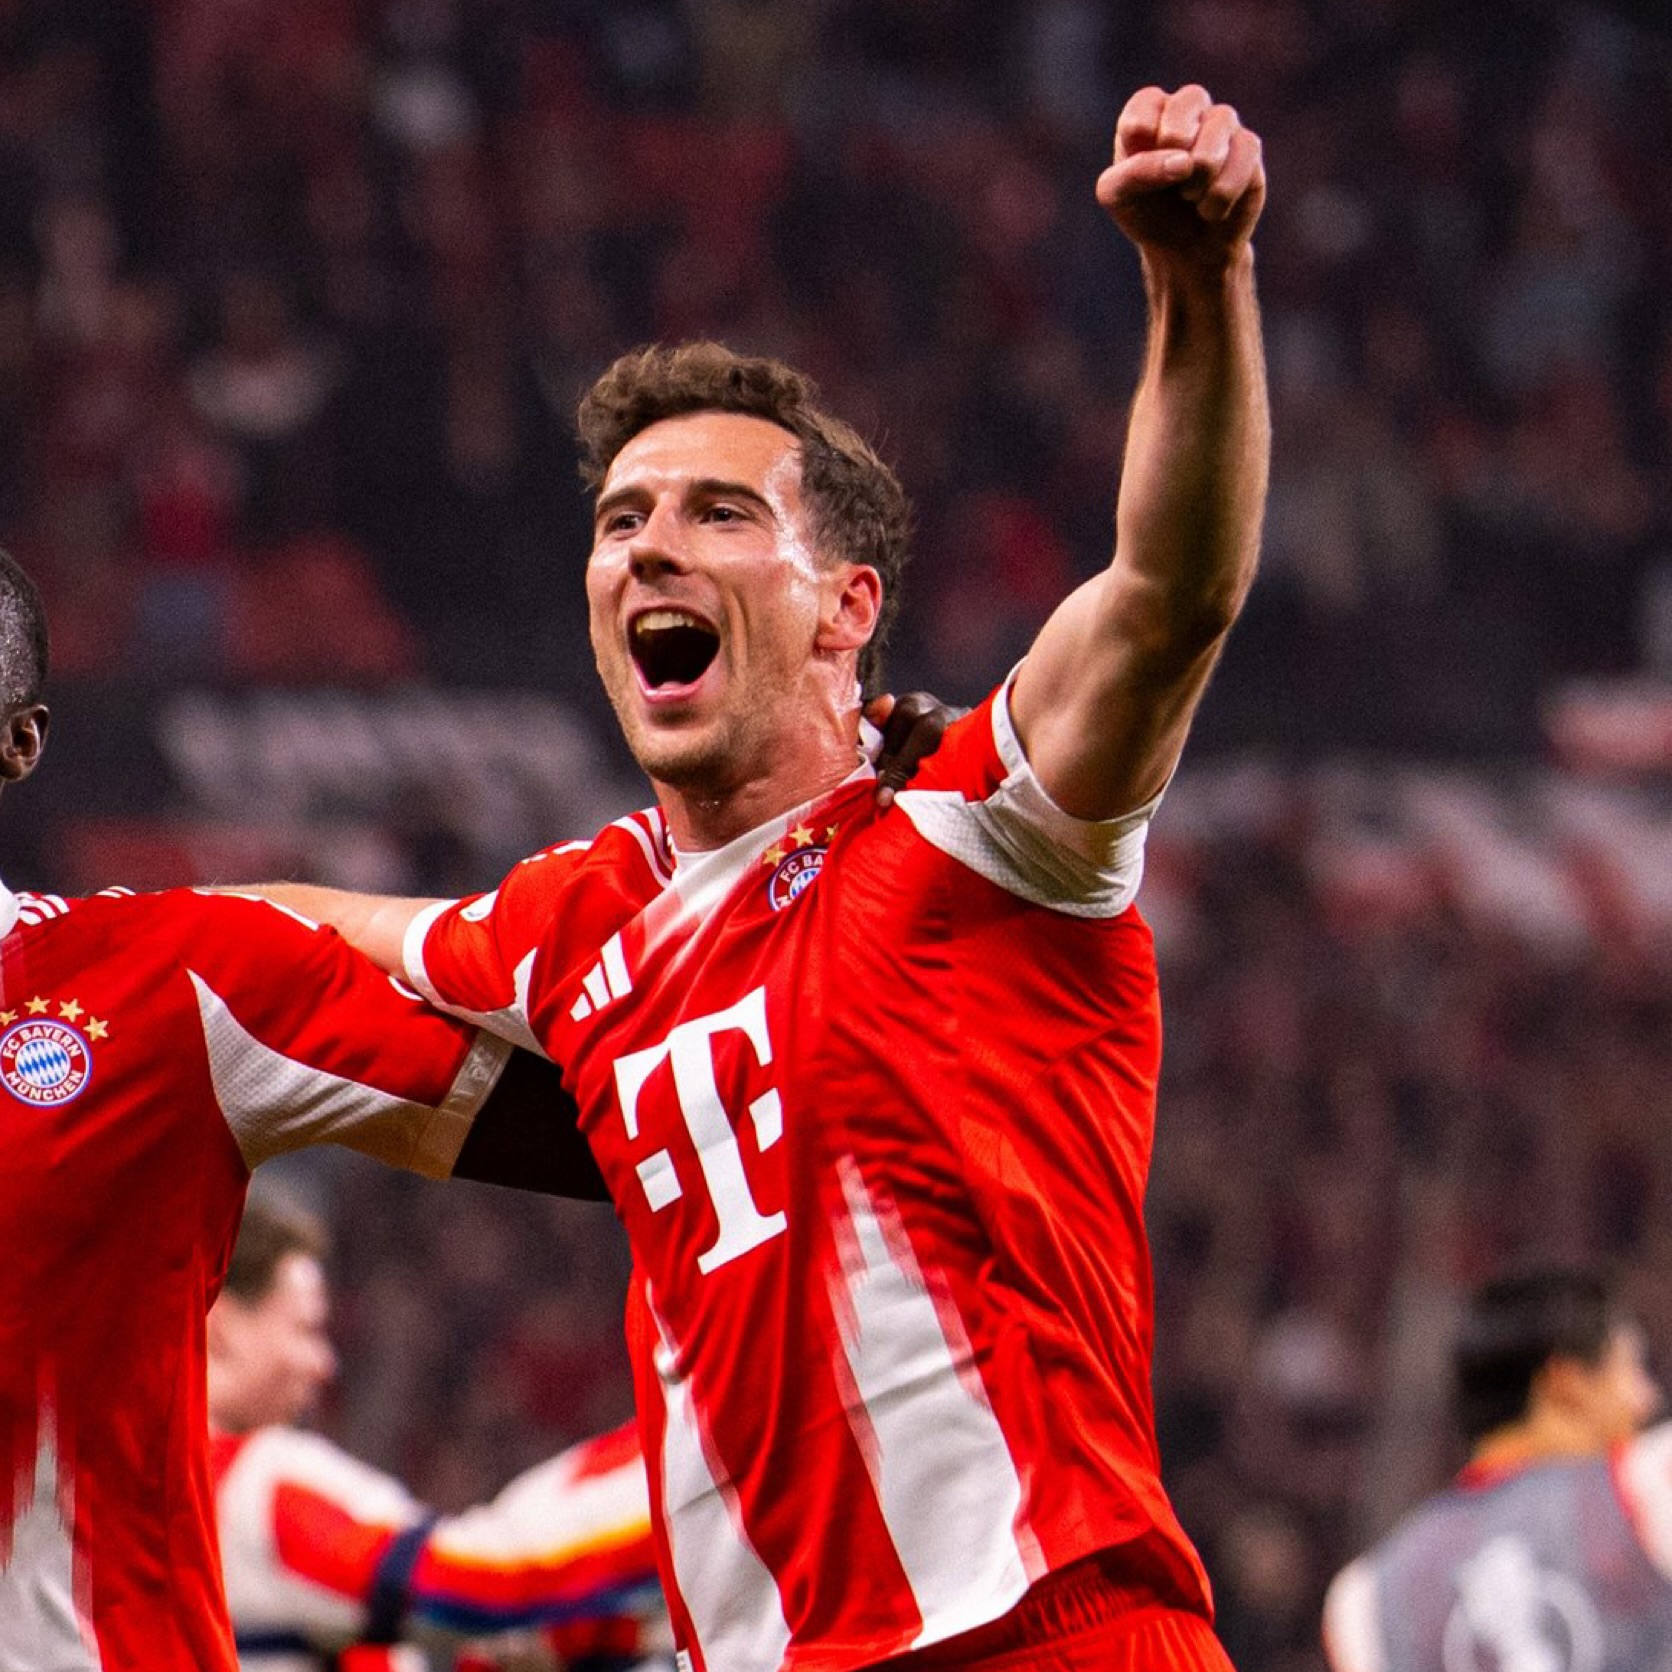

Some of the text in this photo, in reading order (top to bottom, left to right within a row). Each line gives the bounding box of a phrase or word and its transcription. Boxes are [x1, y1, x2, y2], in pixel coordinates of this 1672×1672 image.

[779, 861, 799, 883] FC
[2, 1026, 82, 1059] FC BAYERN
[613, 984, 787, 1276] T
